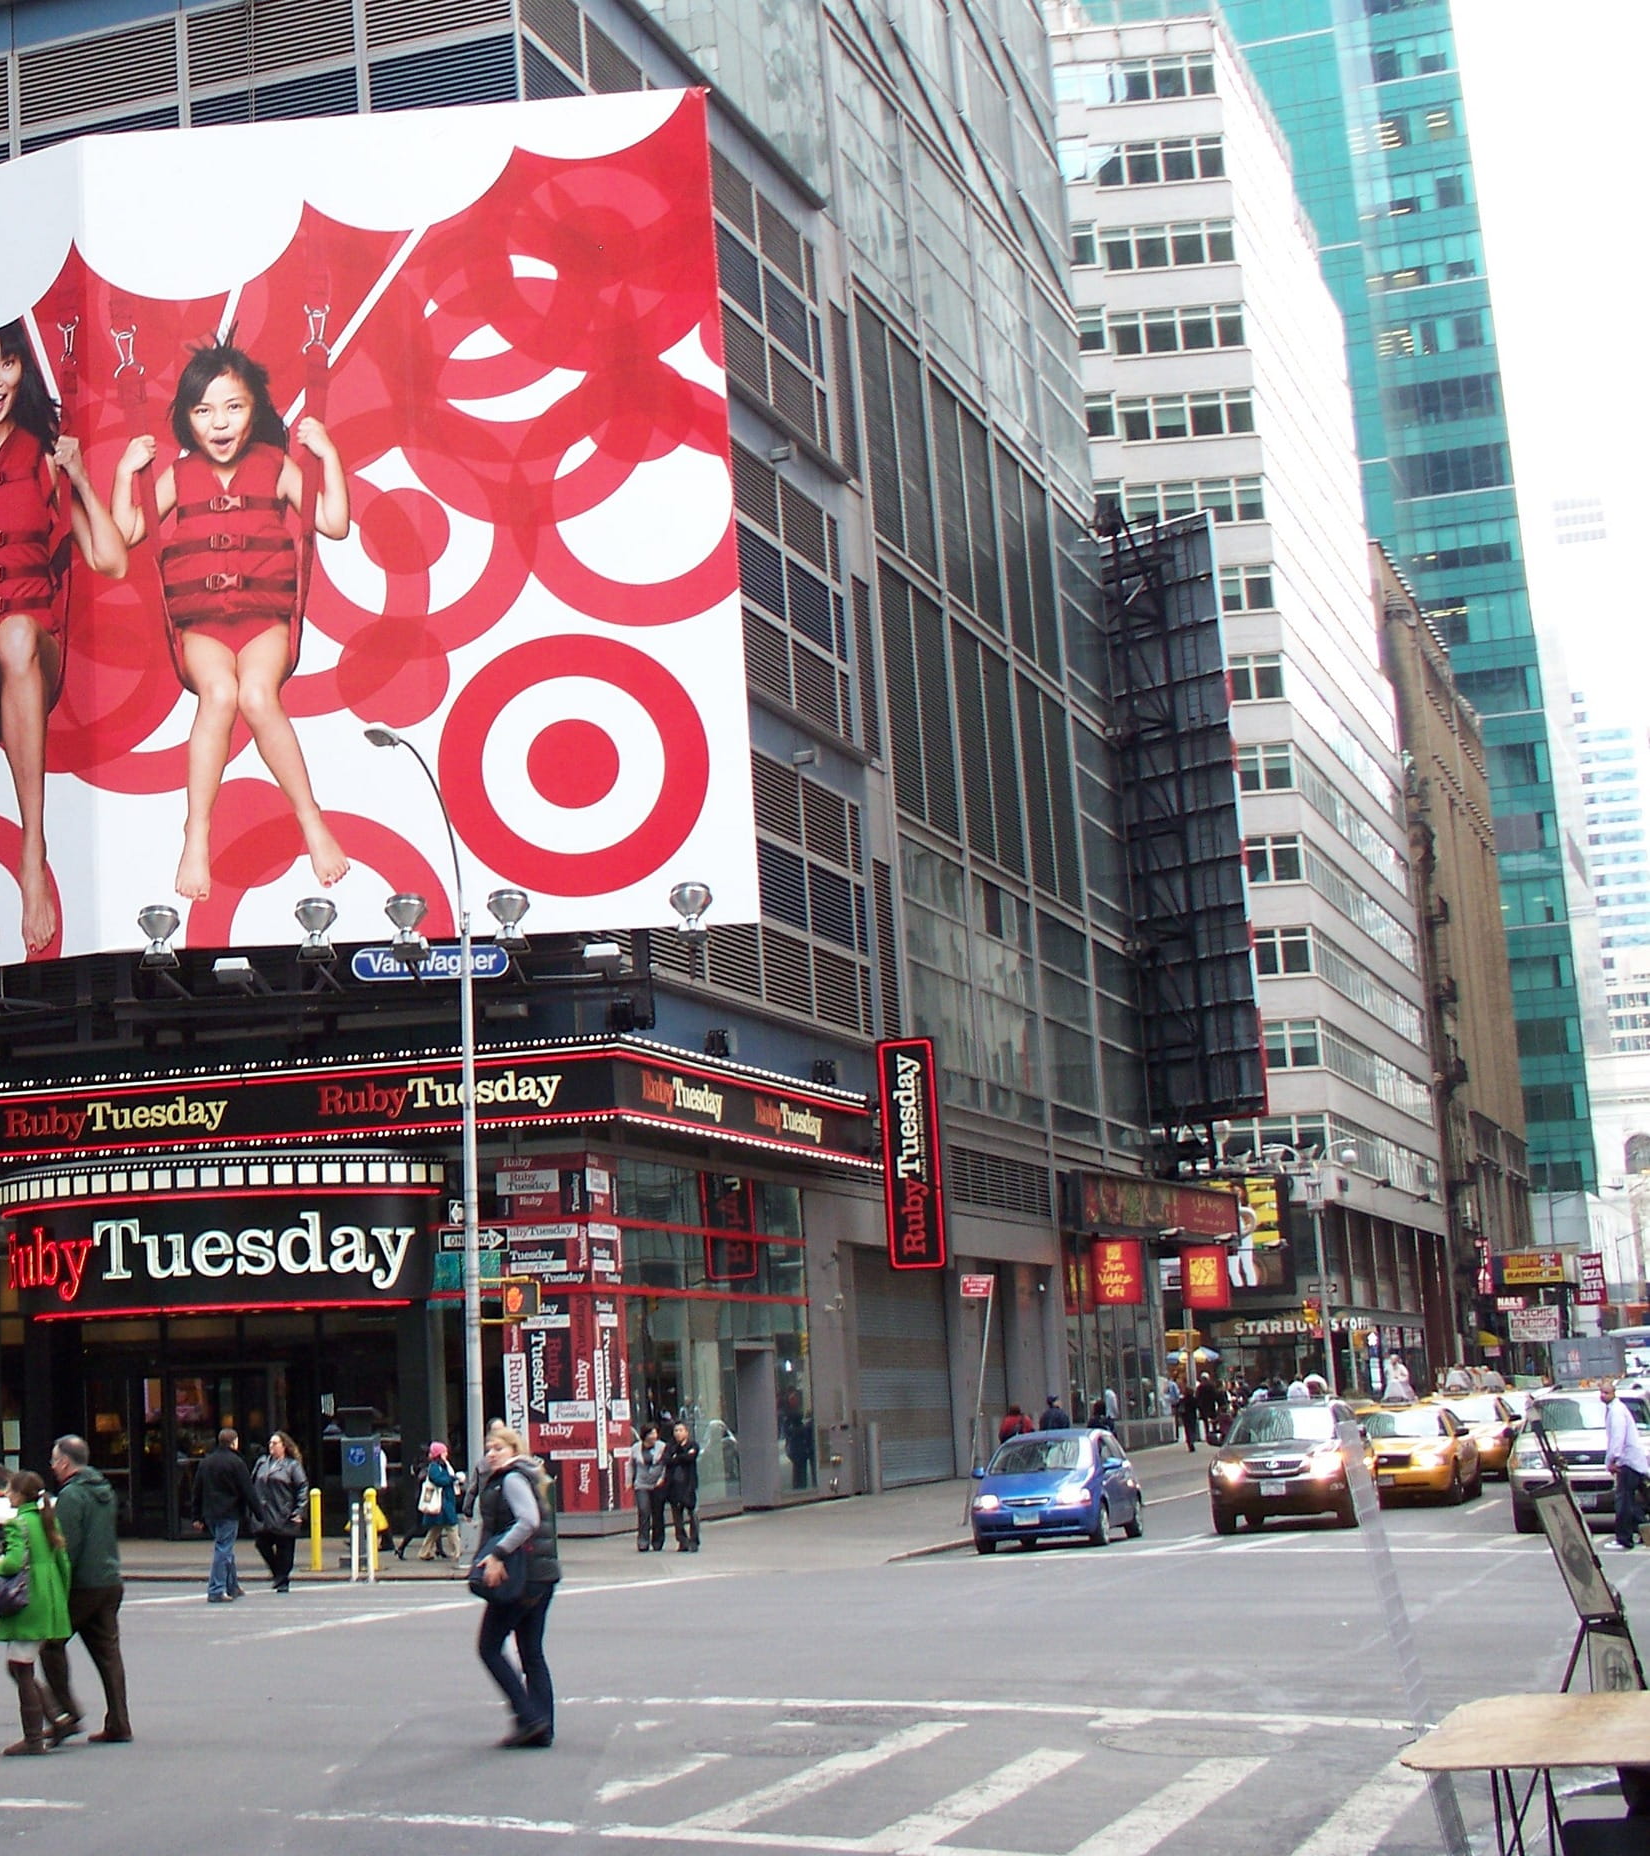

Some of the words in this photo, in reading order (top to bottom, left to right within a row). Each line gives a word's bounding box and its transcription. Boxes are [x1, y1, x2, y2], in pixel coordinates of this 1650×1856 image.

[418, 950, 498, 976] Wager
[503, 1156, 532, 1168] Ruby
[509, 1172, 537, 1183] Ruby
[506, 1180, 551, 1192] Tuesday
[519, 1195, 544, 1206] Ruby
[509, 1224, 573, 1239] ubyTuesday
[508, 1249, 555, 1261] Tuesday
[542, 1272, 586, 1284] Tuesday
[1497, 1296, 1524, 1307] NAILS
[1233, 1317, 1339, 1336] STARBUS
[530, 1331, 548, 1415] Tuesday
[575, 1359, 591, 1401] Ruby
[539, 1423, 575, 1437] Ruby
[578, 1463, 590, 1495] Ruby
